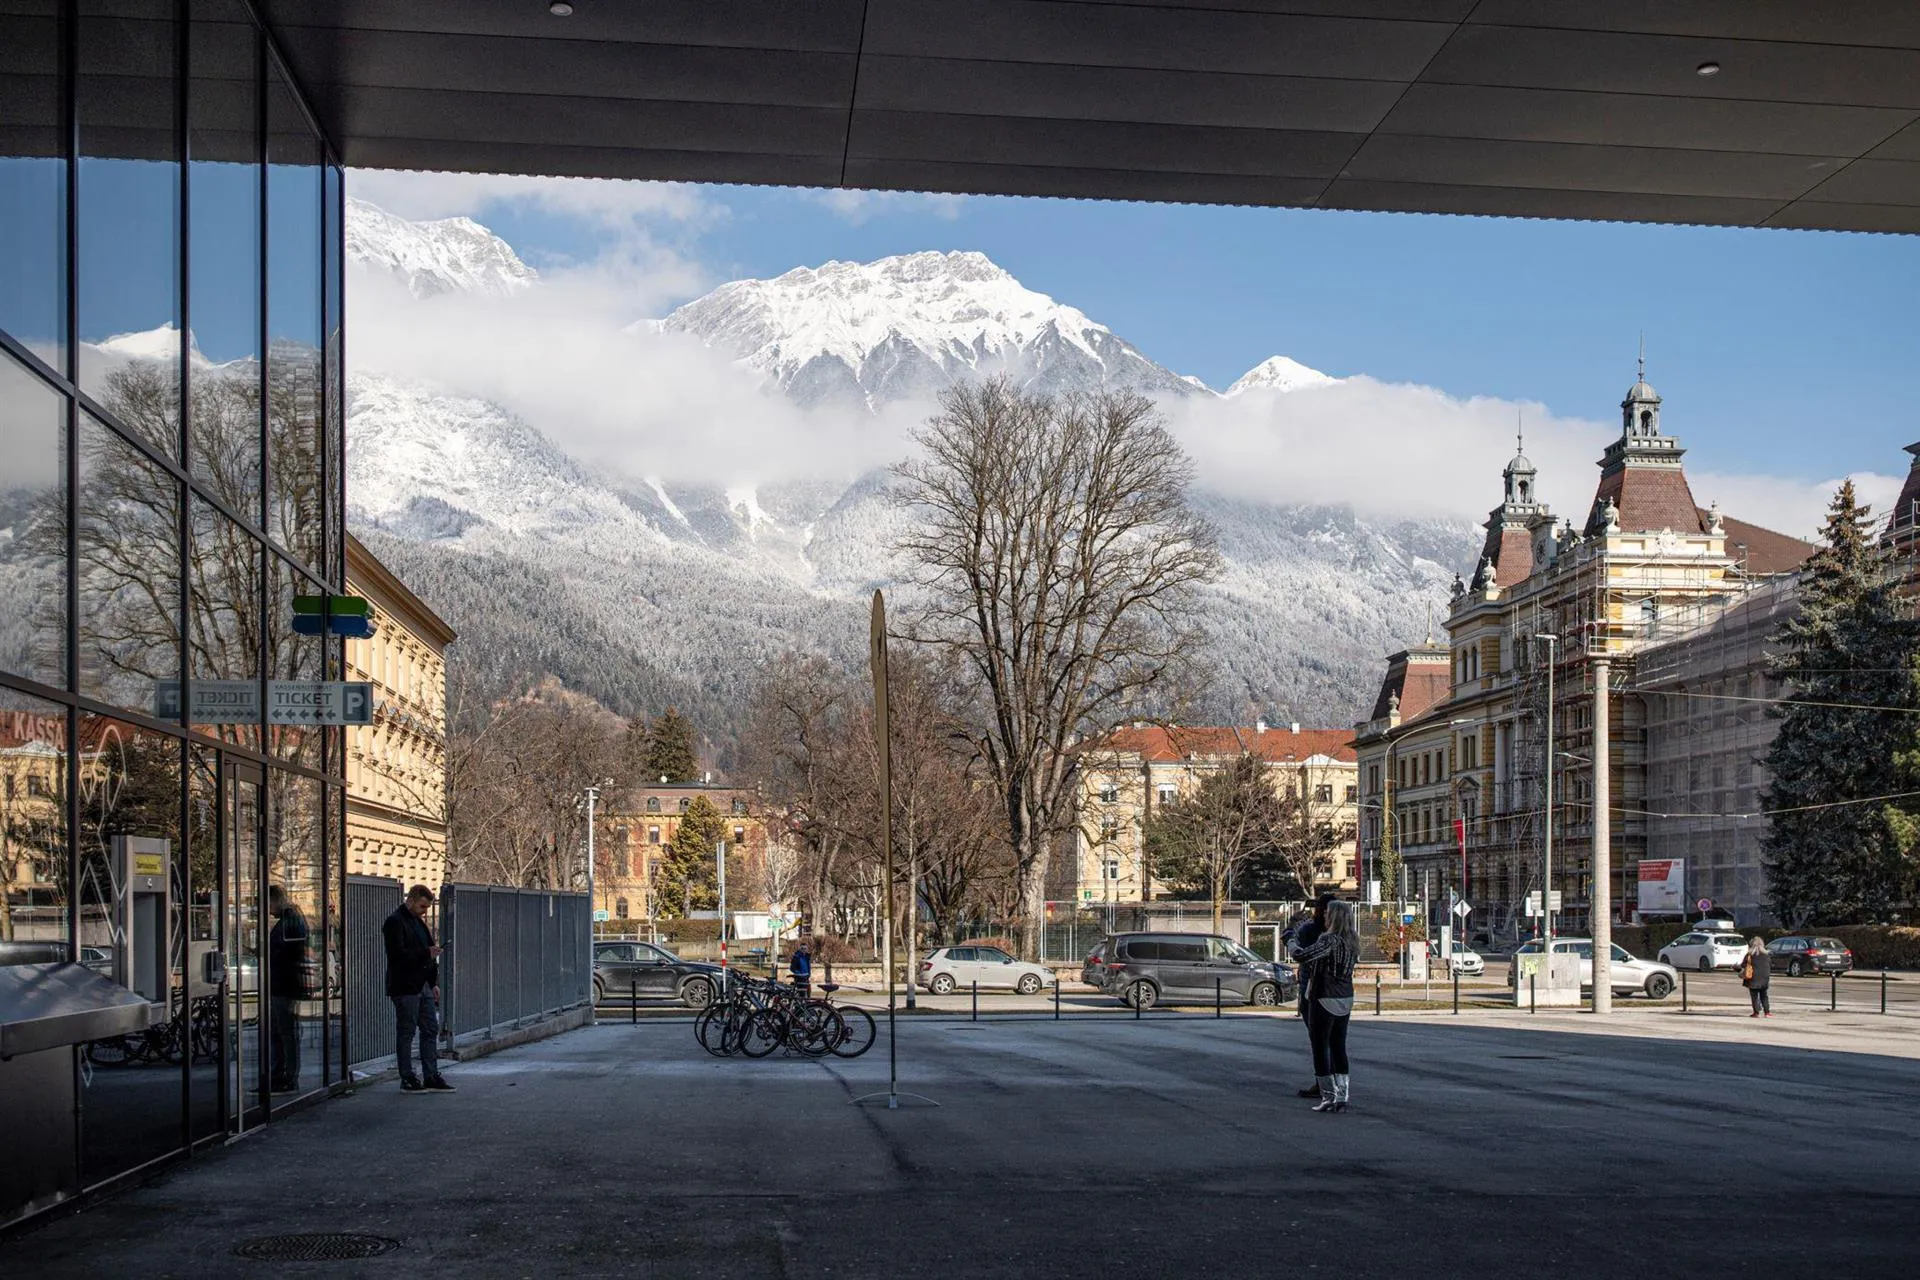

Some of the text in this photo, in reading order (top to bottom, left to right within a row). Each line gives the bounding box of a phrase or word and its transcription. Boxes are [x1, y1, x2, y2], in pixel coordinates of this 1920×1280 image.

[275, 692, 332, 704] TICKET
[347, 692, 364, 714] P
[14, 711, 65, 750] KASSA
